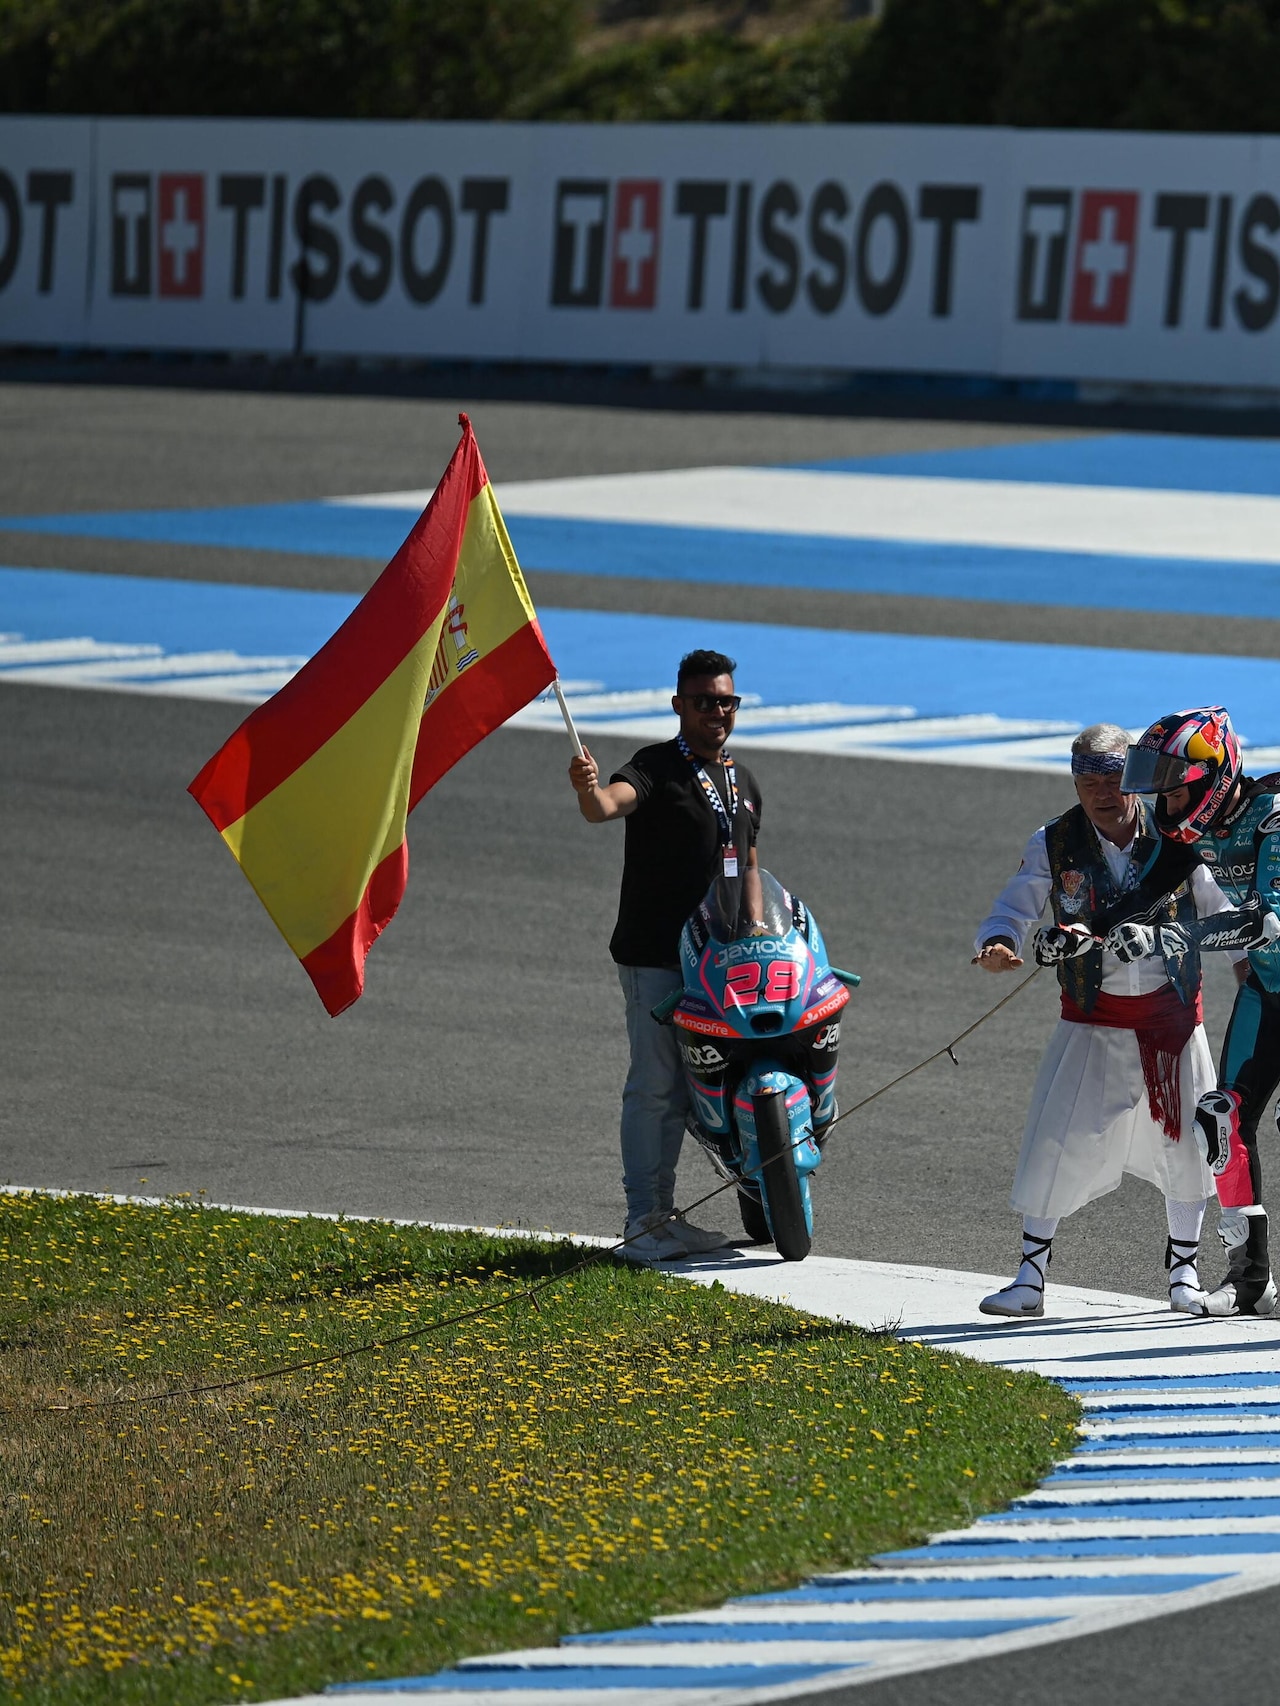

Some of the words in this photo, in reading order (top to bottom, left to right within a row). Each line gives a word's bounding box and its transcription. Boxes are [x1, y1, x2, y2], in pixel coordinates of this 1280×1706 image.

[217, 172, 512, 308] TISSOT
[674, 179, 983, 318] TISSOT
[1140, 747, 1161, 756] WINGS
[1143, 735, 1164, 750] Bull
[1197, 794, 1222, 826] Red
[1215, 775, 1234, 804] Bull
[1200, 921, 1254, 948] aspar
[1220, 936, 1254, 947] CIRCUIT
[723, 960, 801, 1010] 28
[818, 991, 850, 1017] mapfre
[685, 1017, 729, 1036] mapfre
[677, 1042, 724, 1066] iota
